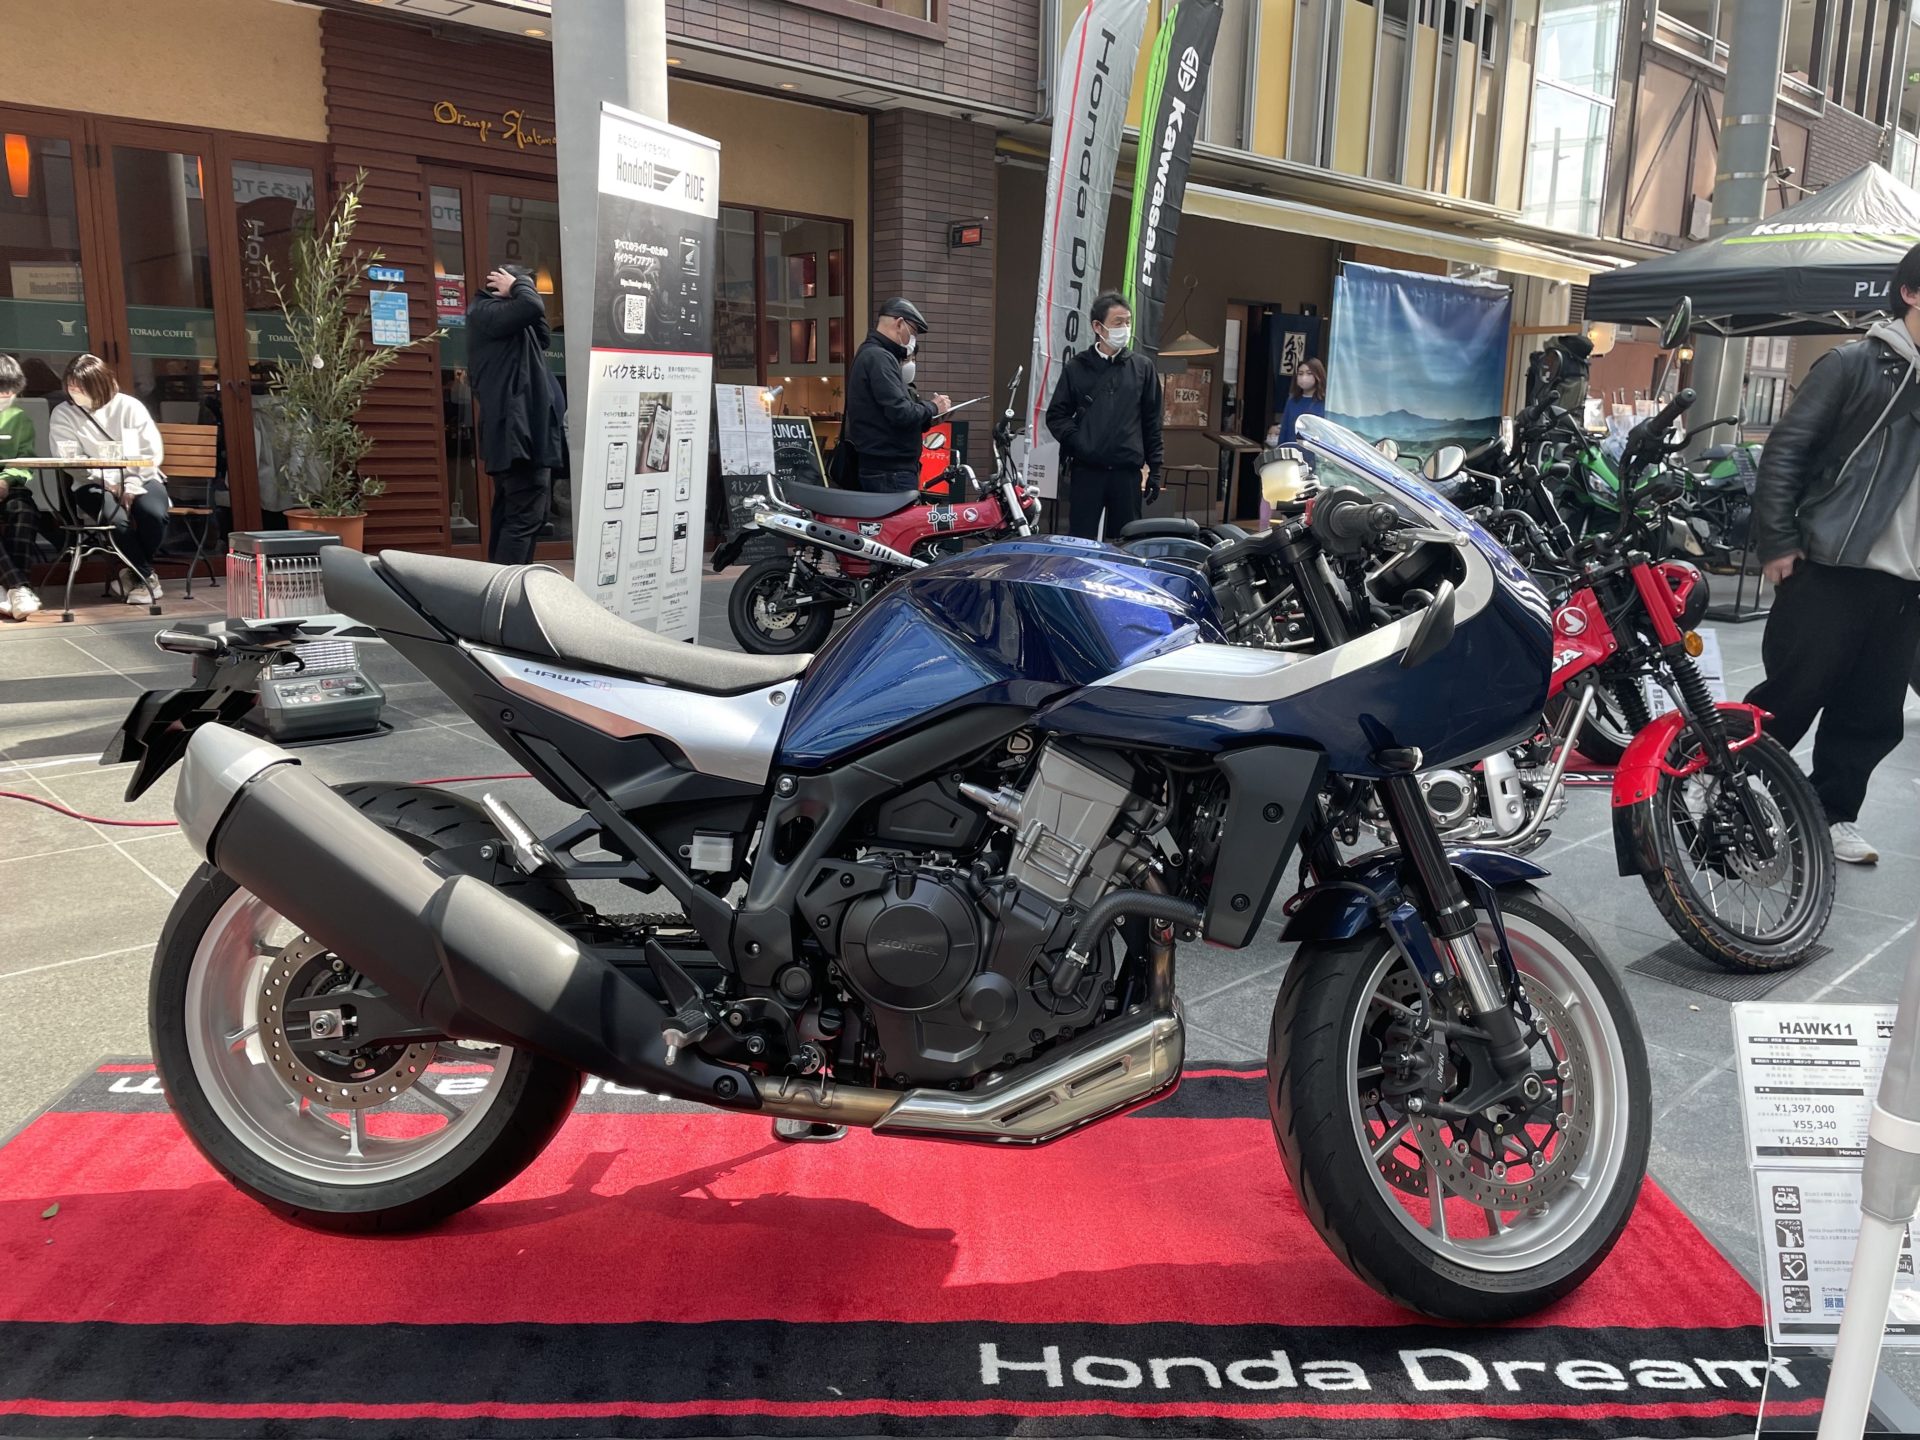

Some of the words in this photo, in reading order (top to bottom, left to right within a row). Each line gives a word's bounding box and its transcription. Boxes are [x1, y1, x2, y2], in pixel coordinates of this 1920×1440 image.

[434, 101, 492, 142] Orange
[1077, 28, 1116, 218] Honda
[616, 153, 653, 189] HondaGO
[685, 172, 705, 202] RIDE
[1142, 97, 1186, 287] Kawasaki
[128, 327, 161, 337] TORAJA
[162, 330, 194, 338] COFFEE
[603, 364, 664, 381] バイクを楽しむ。
[927, 511, 958, 524] Dax
[1778, 1021, 1853, 1036] HAWK11
[1774, 1103, 1835, 1115] ¥1,397,000
[1792, 1120, 1837, 1130] ¥55,340
[1777, 1135, 1839, 1146] ¥1,452,340
[979, 1342, 1372, 1391] Honda
[1399, 1349, 1801, 1392] Dream
